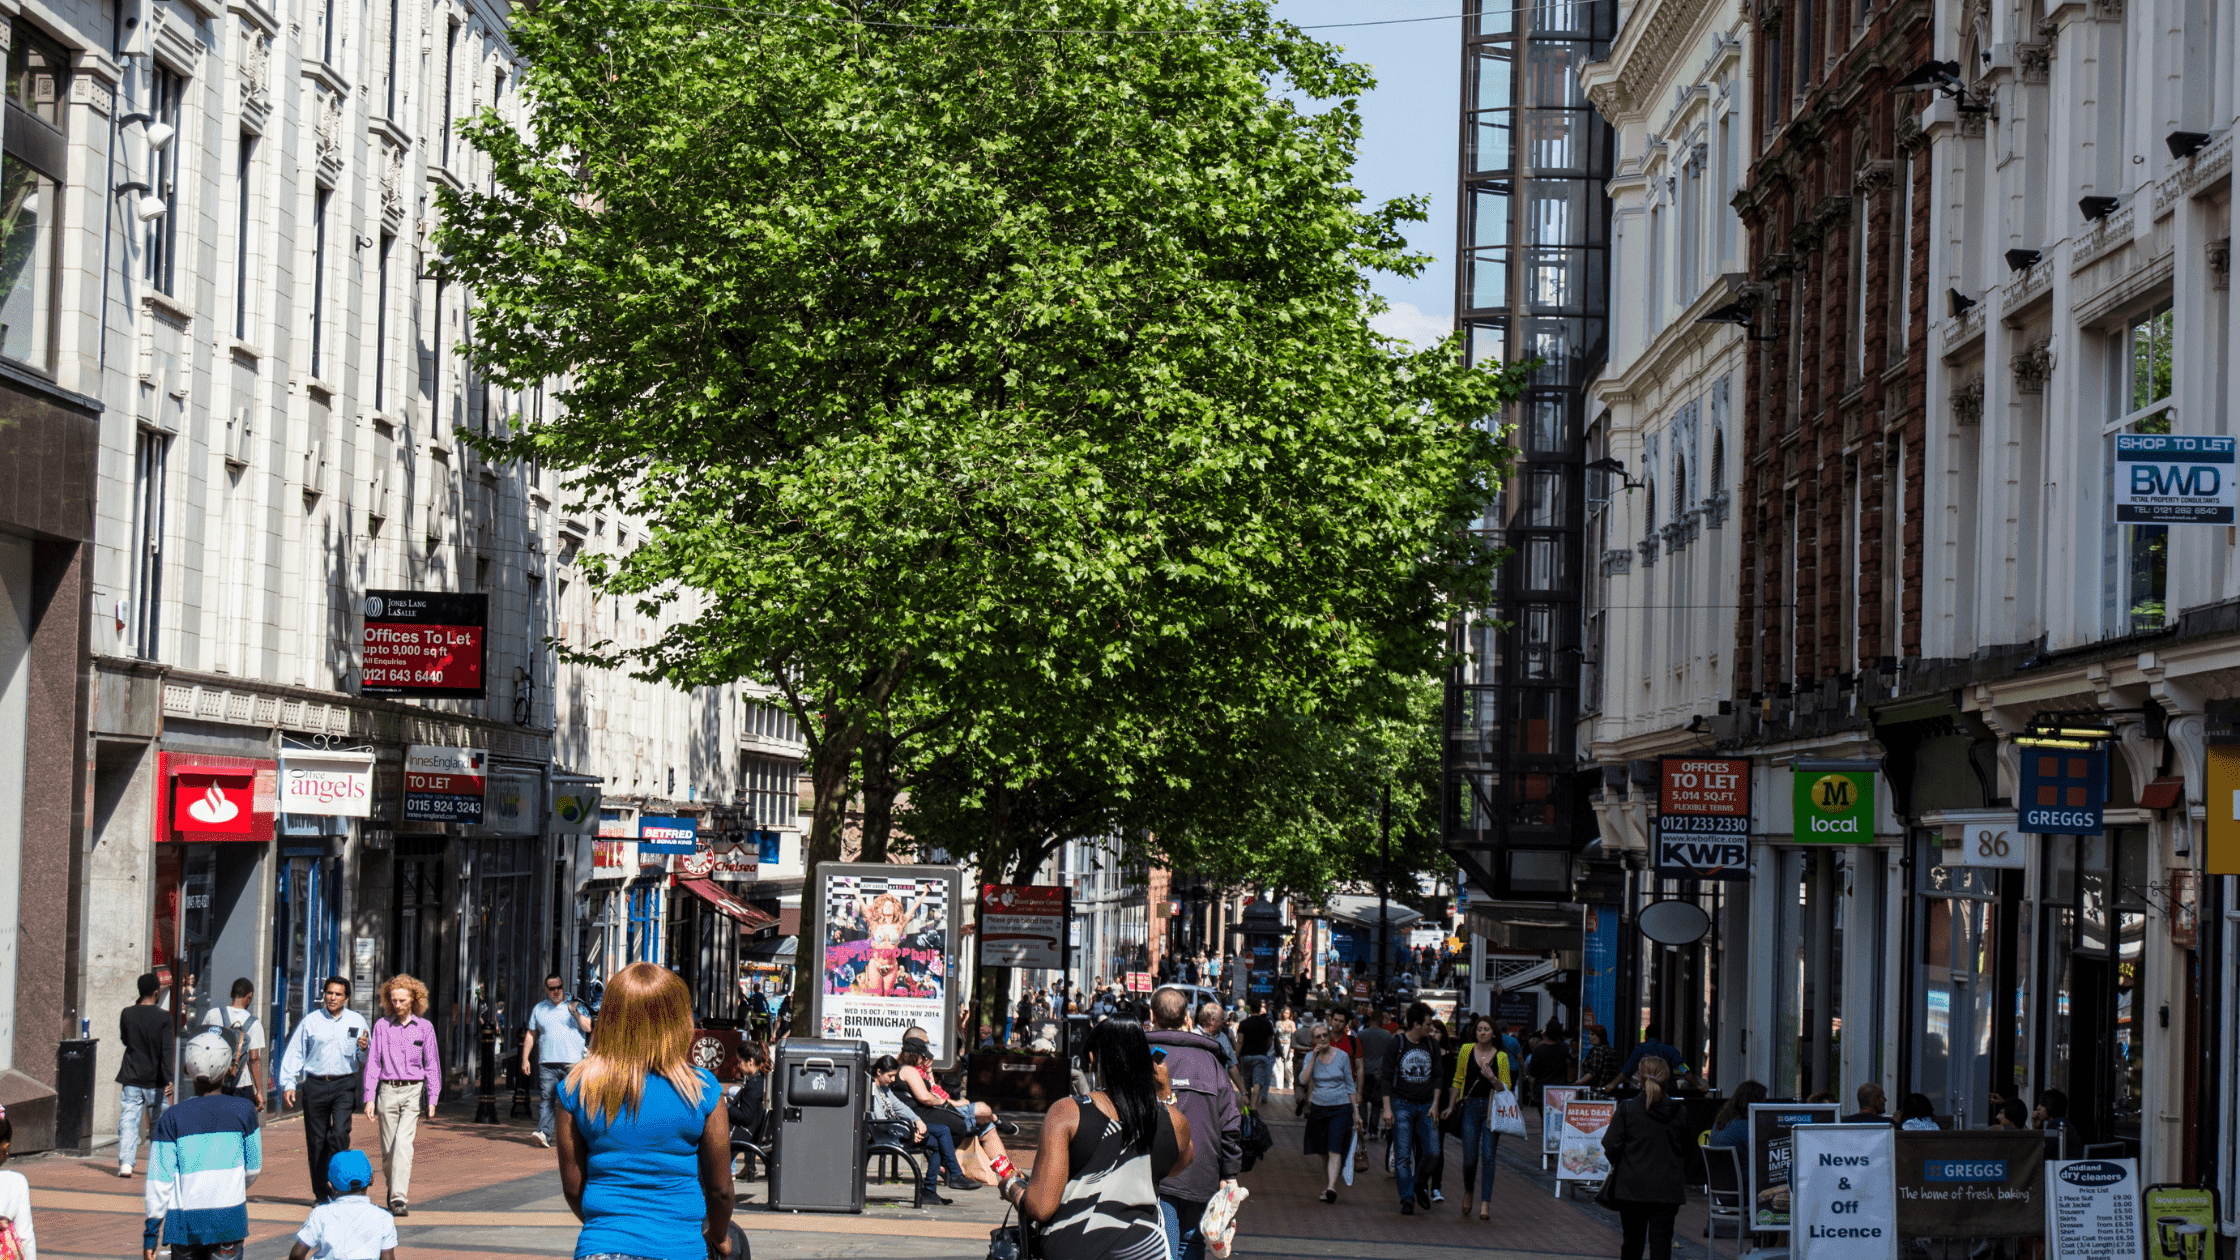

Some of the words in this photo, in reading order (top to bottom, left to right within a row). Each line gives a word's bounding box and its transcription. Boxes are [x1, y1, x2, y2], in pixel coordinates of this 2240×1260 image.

[2120, 438, 2166, 450] SHOP
[2173, 439, 2196, 450] TO
[2202, 440, 2232, 451] LET
[2131, 465, 2221, 496] BWD
[387, 599, 407, 608] JONES
[408, 600, 426, 608] LANG
[363, 628, 420, 643] Offices
[424, 630, 443, 644] To
[446, 631, 471, 645] Let
[392, 645, 421, 656] 9,000
[423, 647, 437, 658] sq
[439, 646, 448, 656] ft
[373, 658, 407, 666] Enquiries
[362, 668, 386, 681] 0121
[389, 670, 411, 681] 643
[414, 671, 444, 683] 6440
[409, 755, 470, 771] InnesEngland
[1681, 762, 1730, 773] OFFICES
[409, 776, 426, 788] TO
[428, 776, 451, 789] LET
[1671, 774, 1698, 788] TO
[1704, 775, 1740, 789] LET
[291, 775, 365, 803] angels
[1672, 791, 1700, 801] 5,014
[1822, 781, 1850, 805] M
[407, 799, 431, 812] 0115
[434, 800, 454, 813] 924
[457, 802, 481, 814] 3243
[406, 812, 458, 820] innes-england.com
[2028, 811, 2095, 827] GREGGS
[1661, 817, 1689, 830] 0121
[1691, 818, 1715, 831] 233
[1716, 818, 1748, 832] 2330
[1810, 815, 1859, 833] local
[644, 828, 694, 840] BETFRED
[1663, 834, 1745, 844] www.kwboffice.com
[1978, 829, 2010, 858] 86
[1662, 842, 1746, 868] KWB
[715, 862, 758, 873] Chelsea
[987, 916, 1006, 924] Please
[1007, 917, 1020, 925] give
[844, 1016, 917, 1029] BIRMINGHAM
[843, 1028, 863, 1038] NIA
[697, 1038, 720, 1049] COSTA
[695, 1055, 722, 1069] COFFEE
[1567, 1109, 1590, 1117] MEAL
[1590, 1110, 1612, 1118] DEAL
[1769, 1147, 1793, 1162] NE
[1818, 1153, 1870, 1167] News
[1945, 1164, 2004, 1178] GREGGS
[2068, 1163, 2102, 1171] midland
[2060, 1170, 2081, 1180] dry
[2081, 1172, 2123, 1181] cleaners
[1837, 1176, 1852, 1190] &
[1899, 1186, 1918, 1199] The
[1920, 1186, 1949, 1199] home
[1951, 1185, 1964, 1199] of
[1965, 1184, 1995, 1200] fresh
[1997, 1186, 2030, 1203] baking
[2155, 1196, 2175, 1204] Now
[2176, 1195, 2209, 1205] serving
[1830, 1200, 1859, 1214] Off
[1809, 1225, 1882, 1239] Licence
